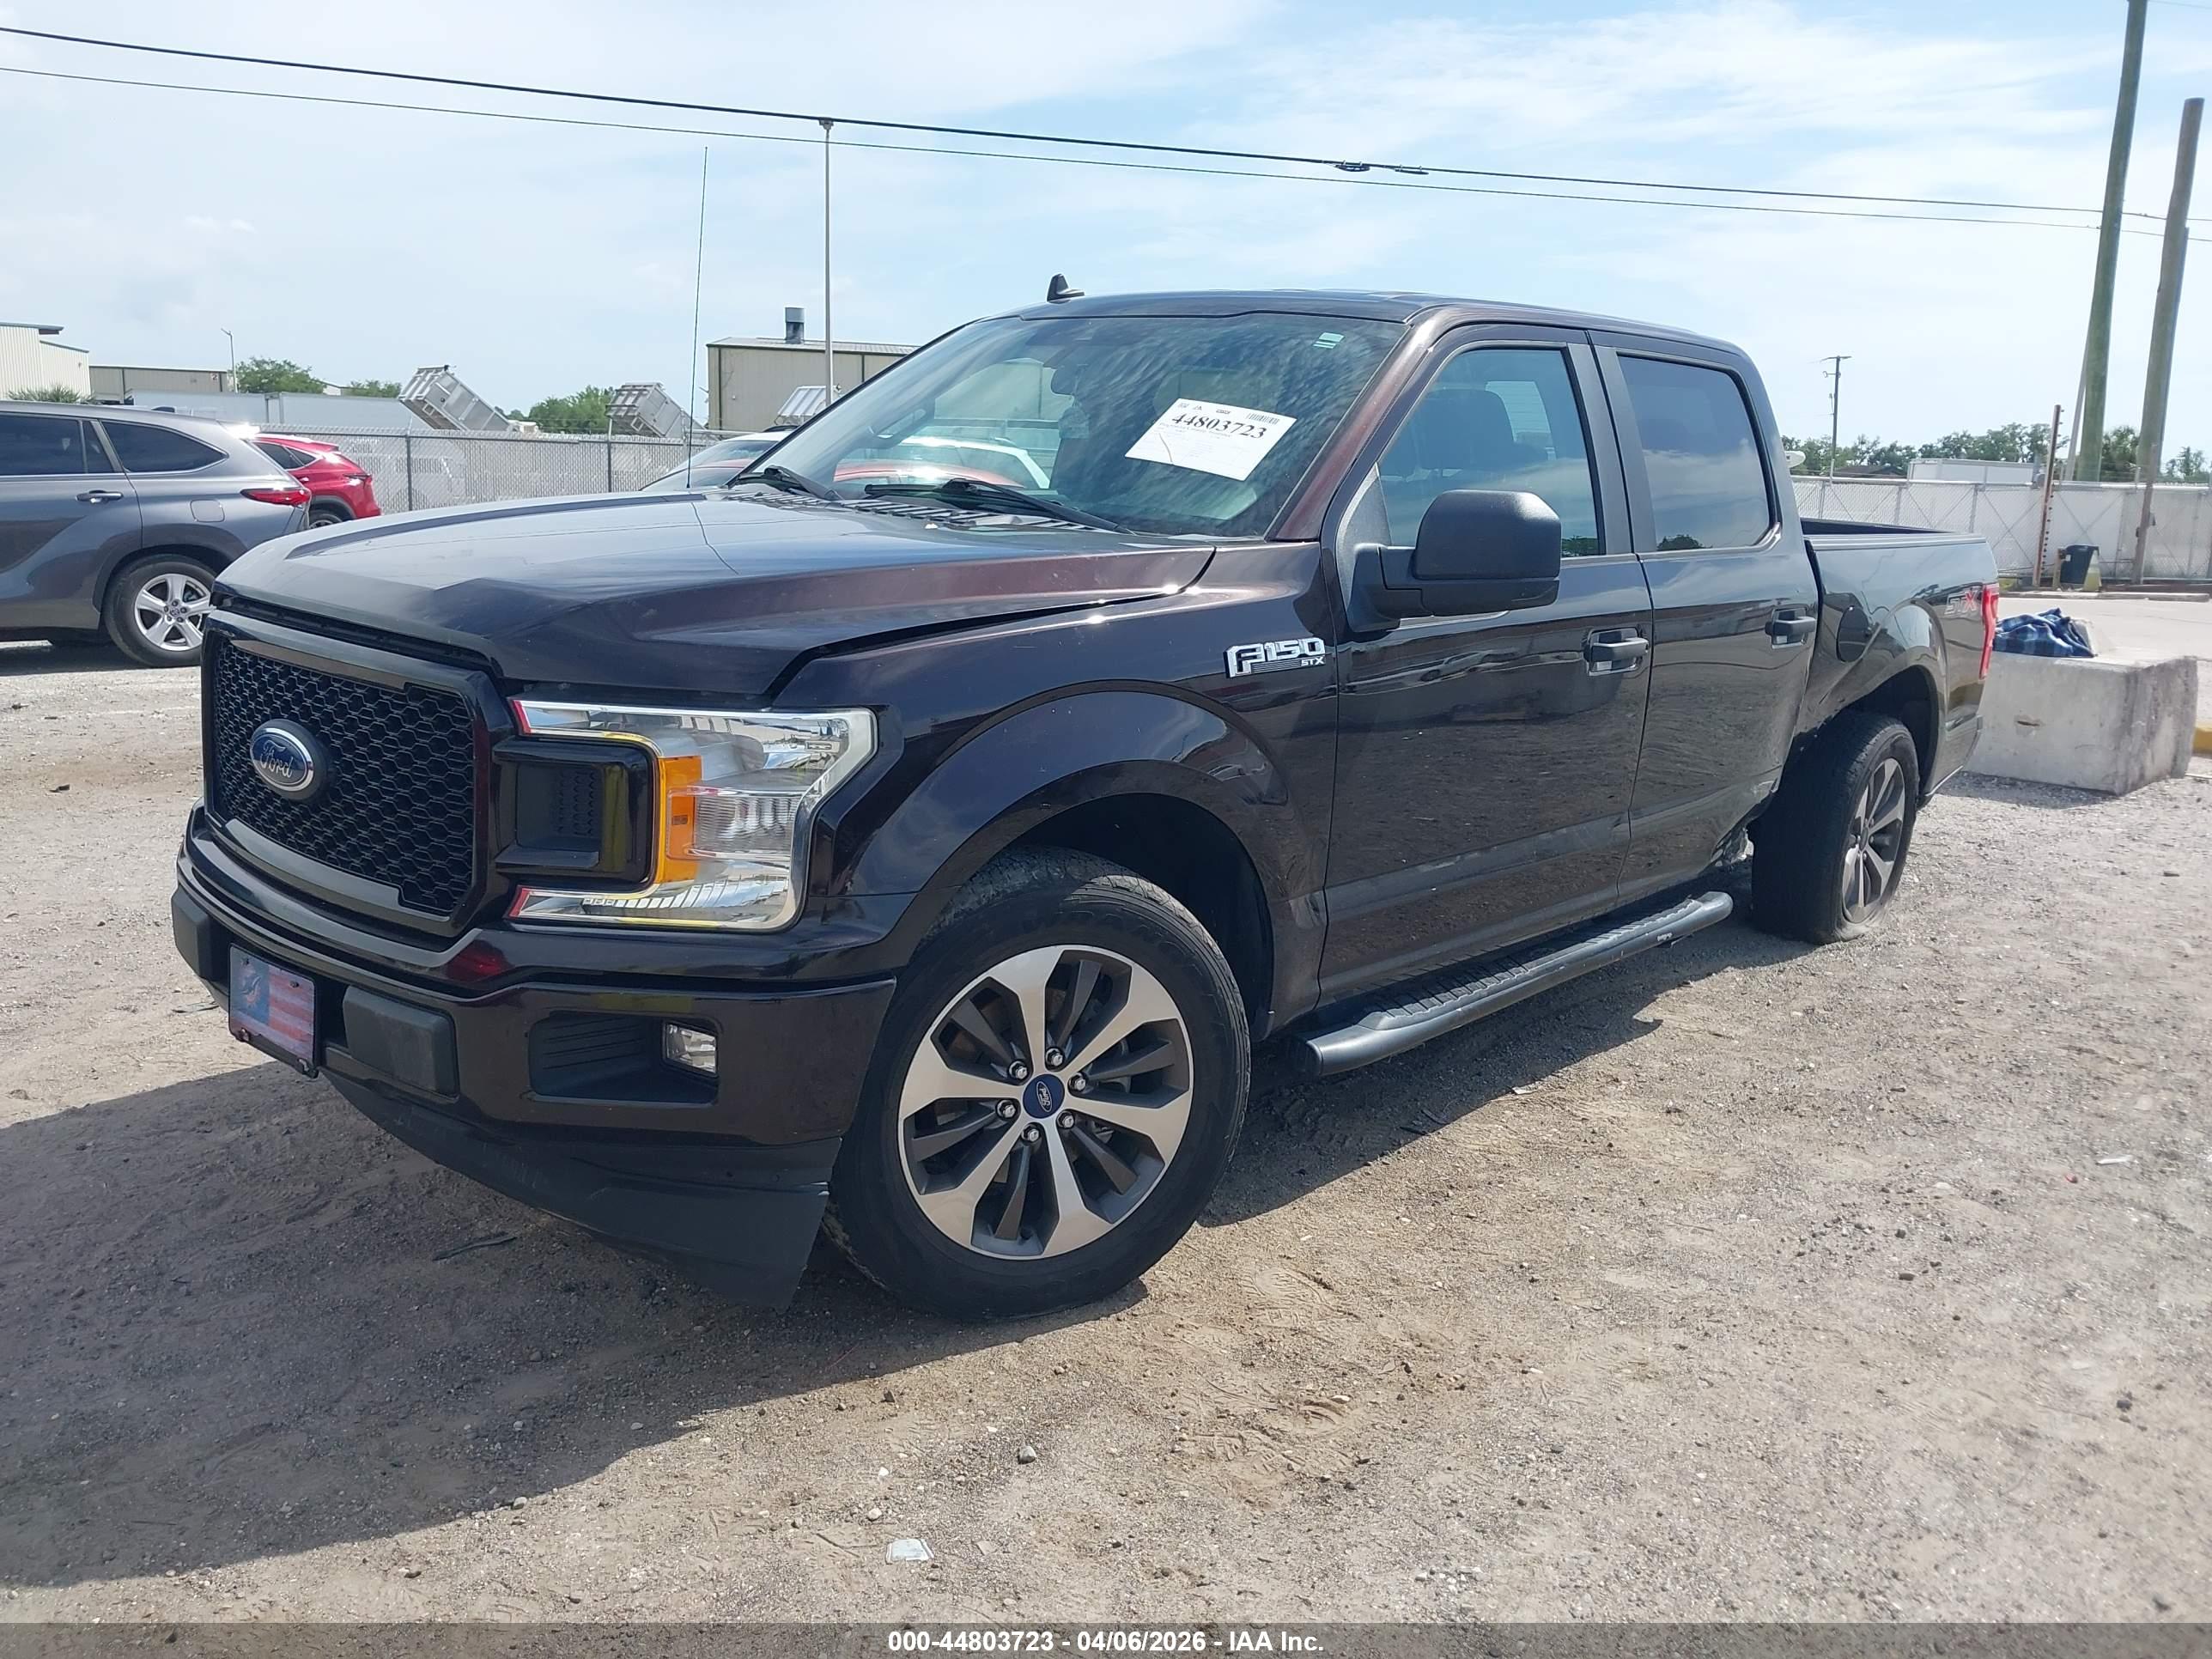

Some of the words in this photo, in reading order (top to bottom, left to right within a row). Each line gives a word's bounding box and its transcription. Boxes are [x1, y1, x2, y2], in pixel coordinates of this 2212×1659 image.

[1171, 413, 1267, 439] 44803723
[1300, 655, 1325, 666] STX
[259, 739, 294, 778] Ford
